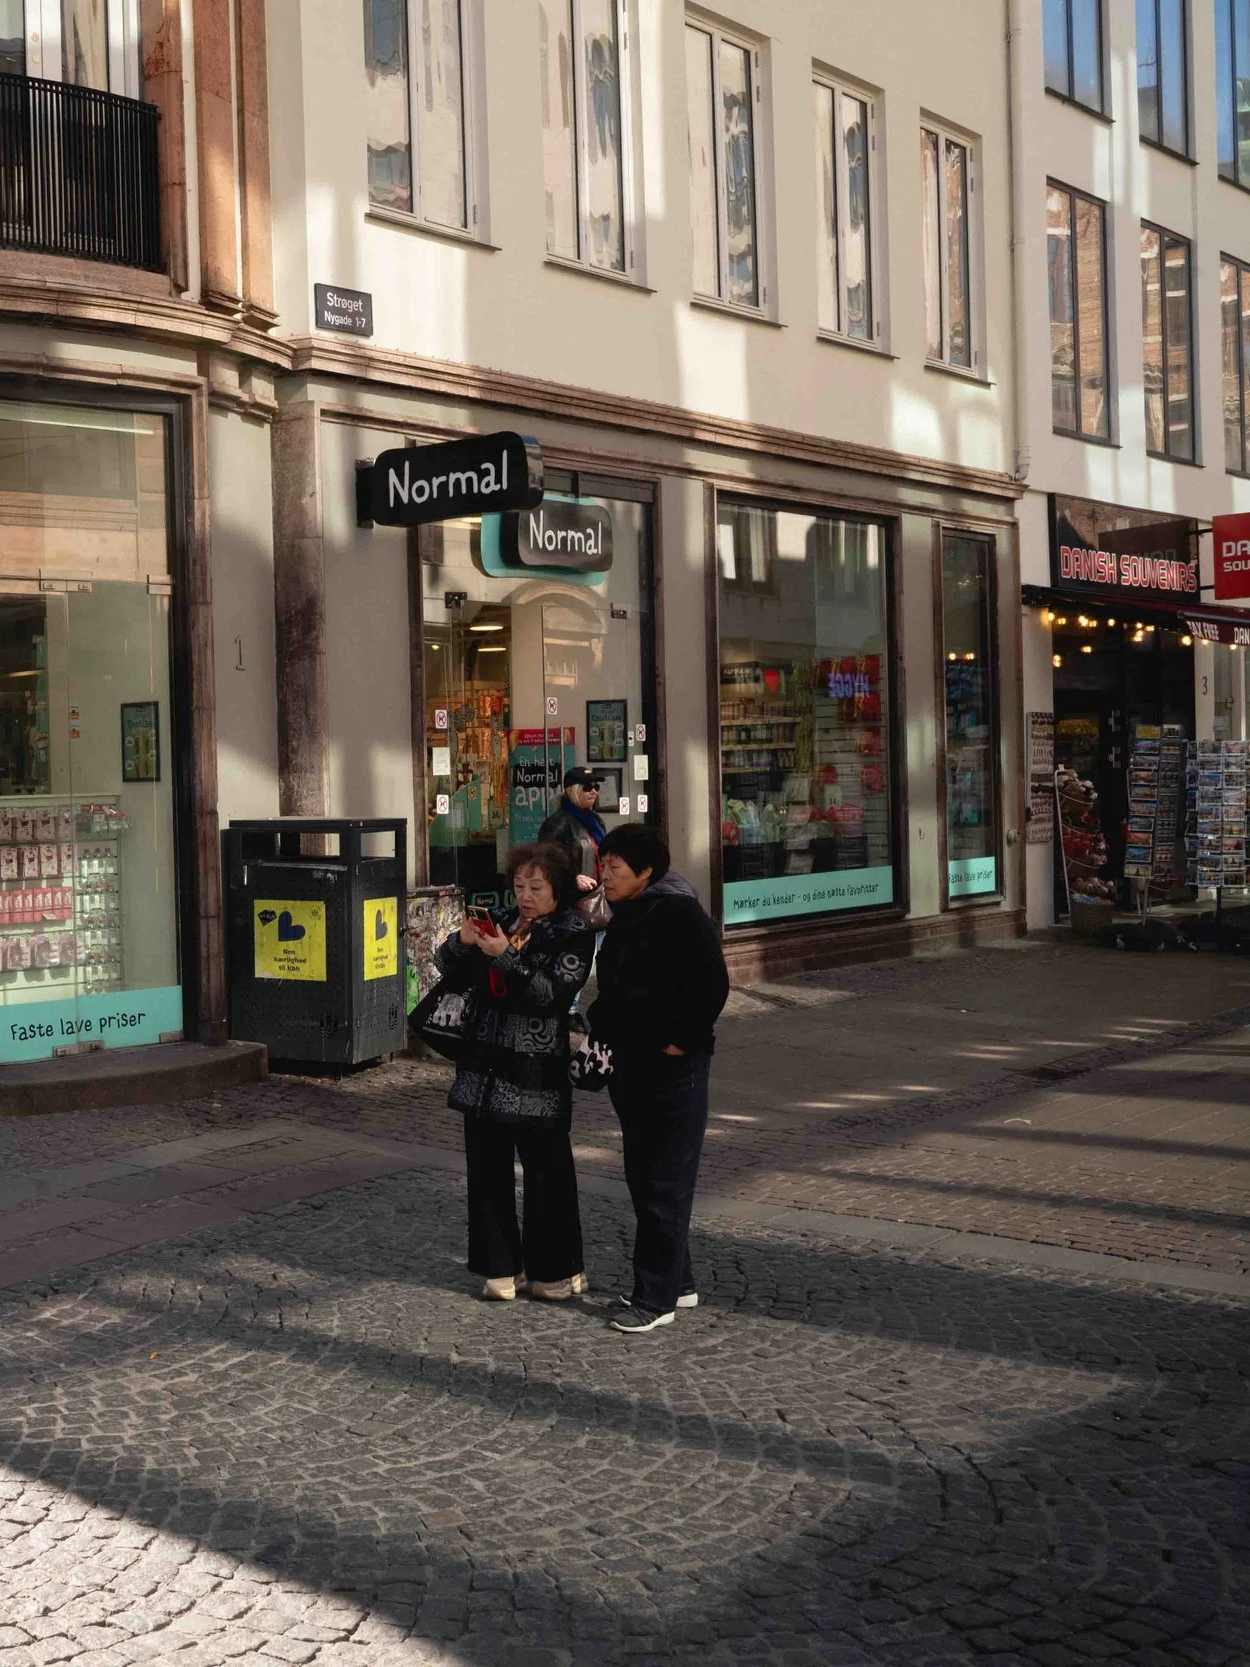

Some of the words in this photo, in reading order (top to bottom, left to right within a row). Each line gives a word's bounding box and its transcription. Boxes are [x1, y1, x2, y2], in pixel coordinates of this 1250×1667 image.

[326, 292, 363, 312] Strøget
[324, 310, 352, 325] Nygade
[356, 317, 366, 328] 1-7
[388, 449, 508, 508] Normal
[529, 509, 602, 555] Normal
[1060, 546, 1117, 584] DANISH
[1120, 555, 1197, 593] SOUVENIRS
[1203, 622, 1220, 641] FREE
[1201, 675, 1208, 695] 3
[733, 896, 760, 910] Mærker
[772, 892, 796, 906] kender
[11, 1023, 54, 1041] Faste
[60, 1018, 93, 1035] lave
[99, 1012, 146, 1034] priser
